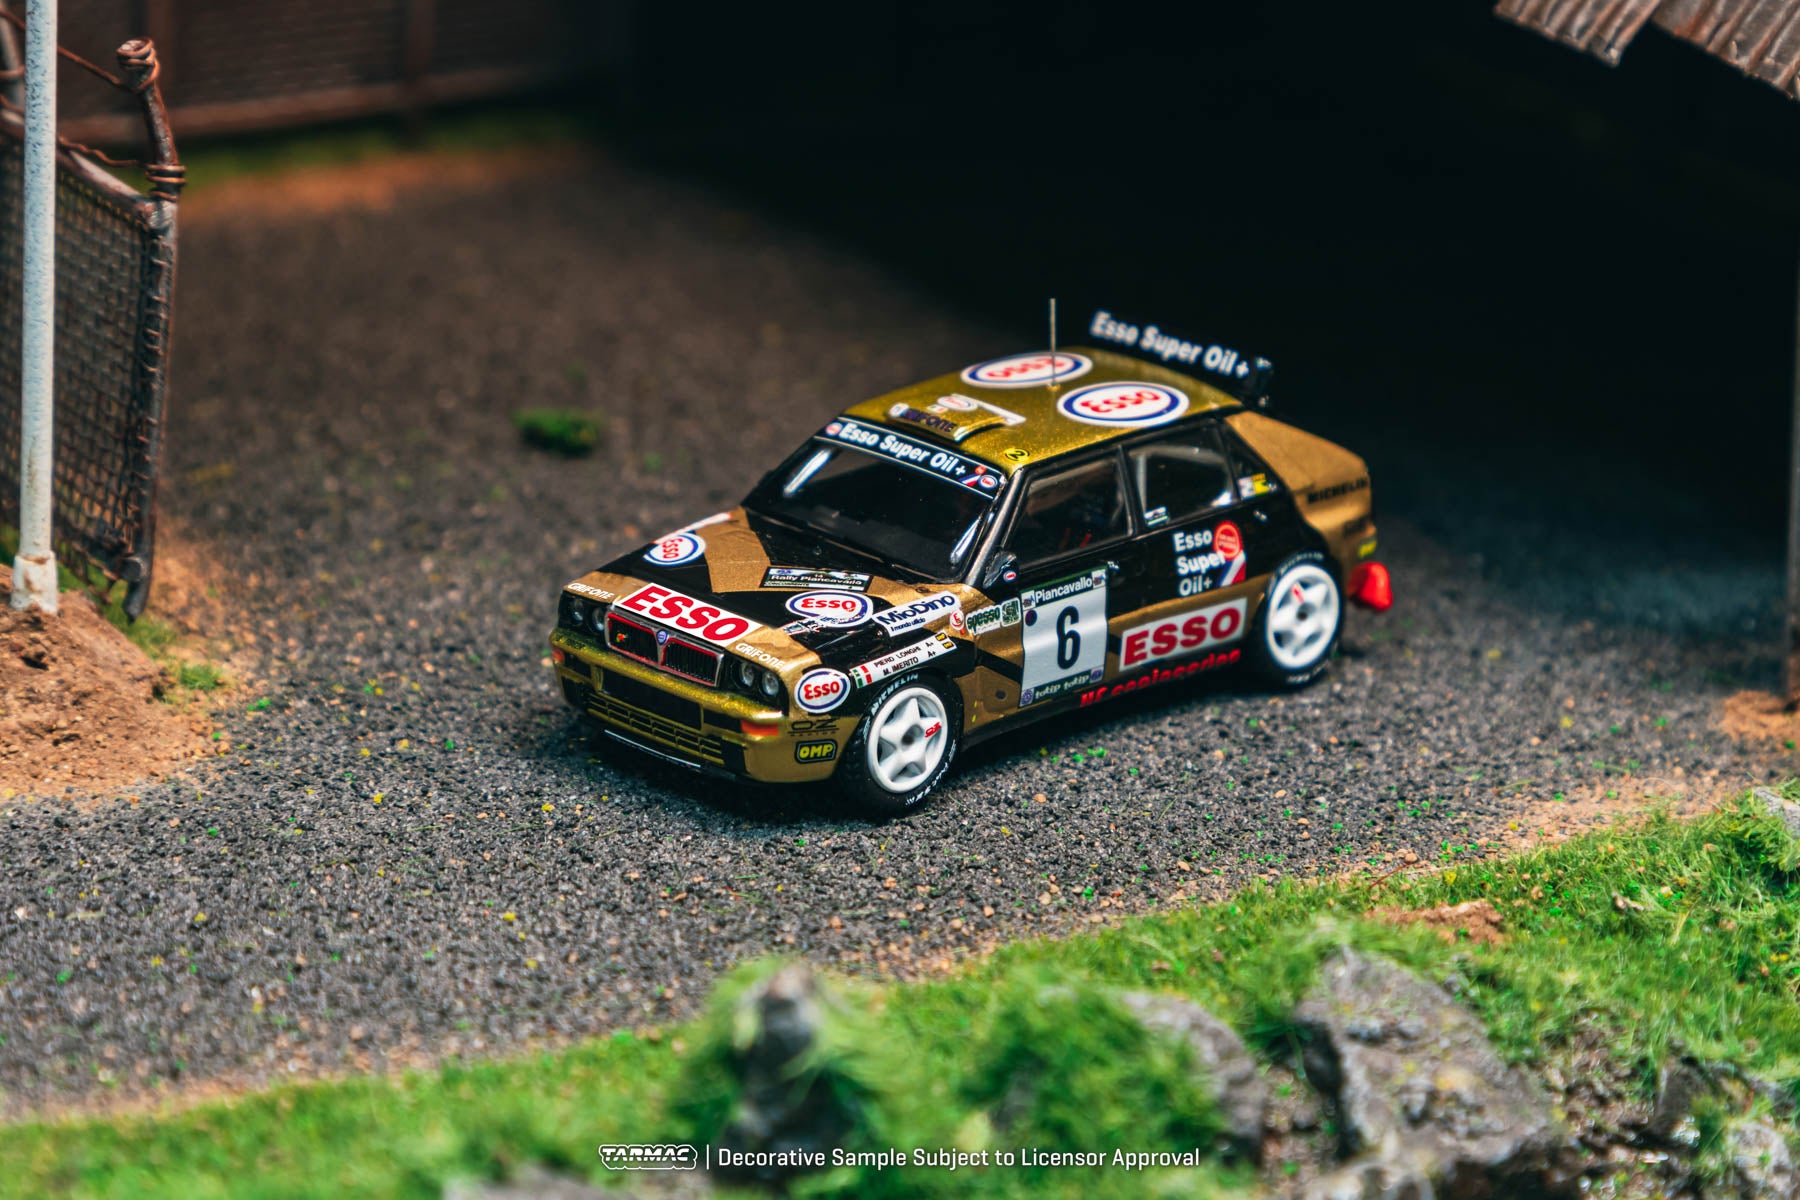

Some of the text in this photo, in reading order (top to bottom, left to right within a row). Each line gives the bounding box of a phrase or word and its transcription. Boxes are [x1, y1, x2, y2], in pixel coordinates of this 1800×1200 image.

[1091, 311, 1138, 344] Esso
[1140, 325, 1201, 364] Super
[838, 423, 880, 446] Esso
[880, 435, 932, 463] Super
[1174, 531, 1213, 552] Esso
[1177, 552, 1226, 575] Super
[567, 582, 615, 600] GRIFONE
[1035, 576, 1092, 603] Piancavallo
[620, 586, 749, 641] ESSO
[876, 595, 955, 625] MioDino
[1056, 605, 1081, 669] 6
[1124, 607, 1241, 667] ESSO
[735, 643, 786, 669] GRIFONE
[799, 743, 834, 759] OMP
